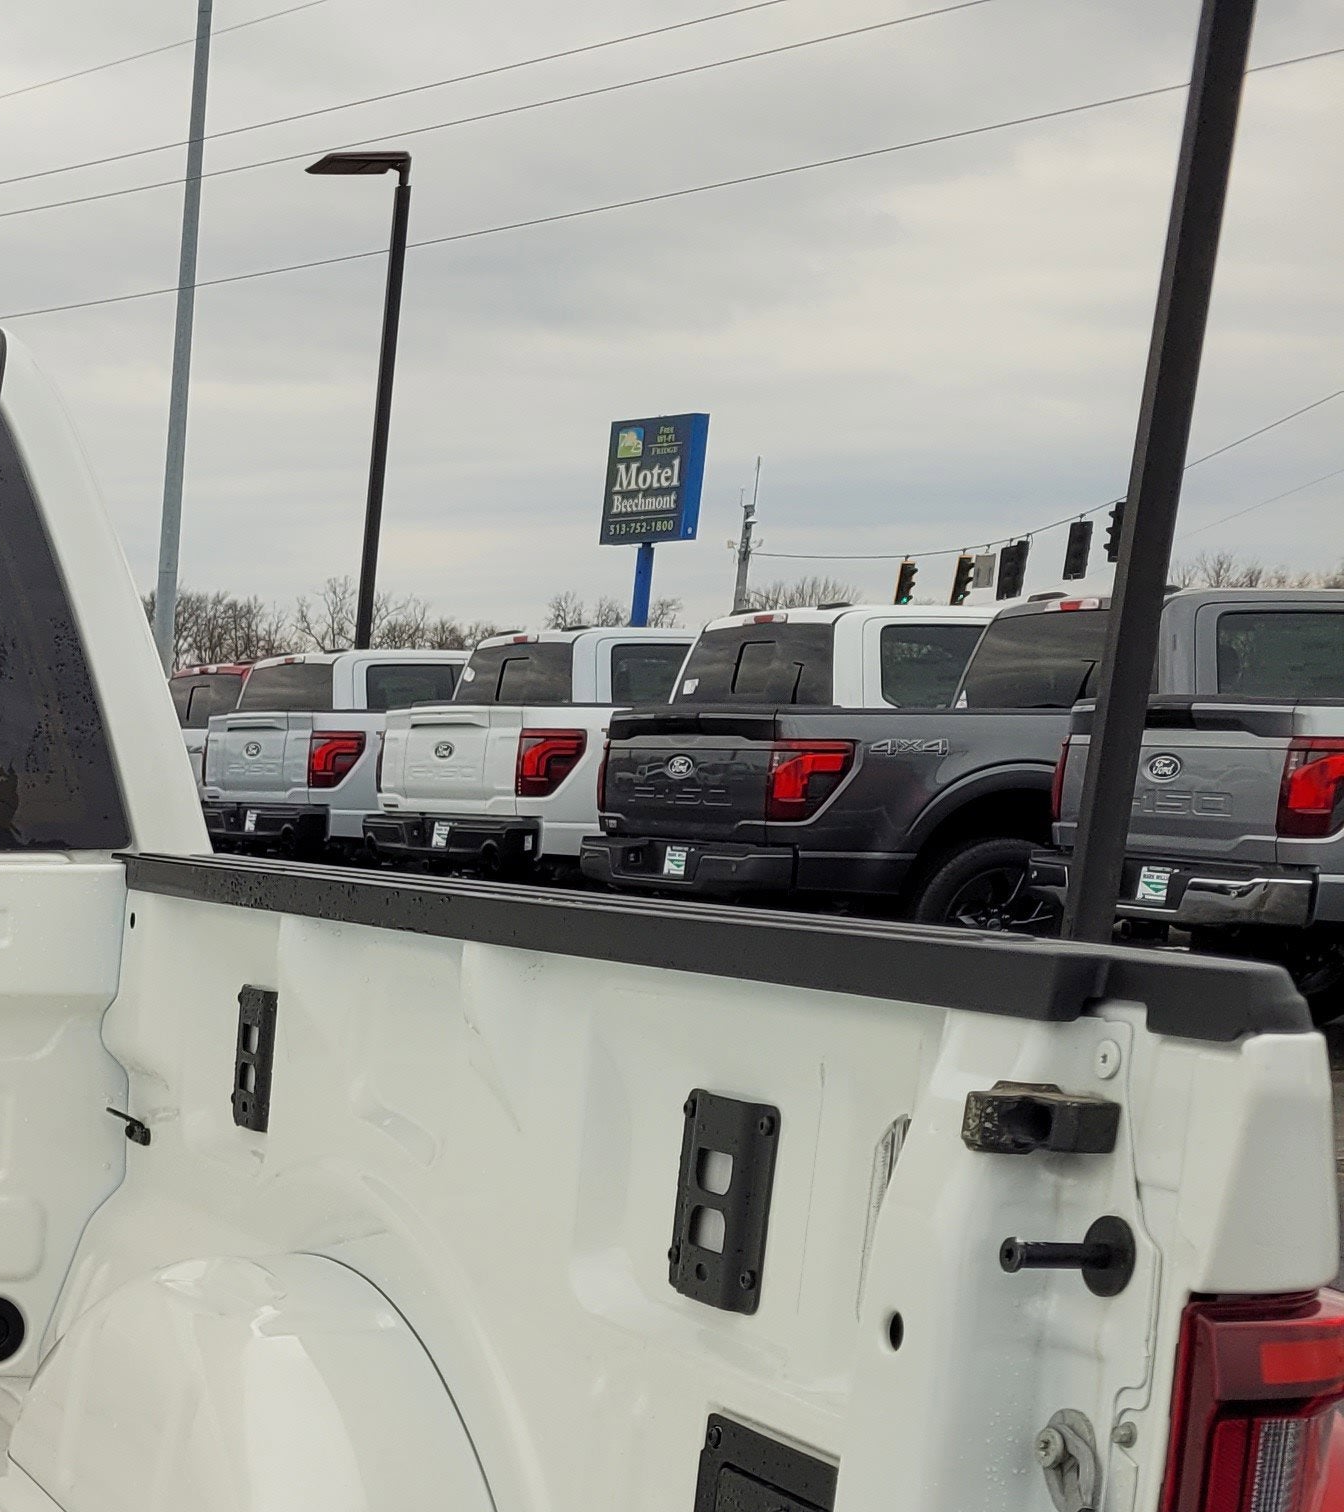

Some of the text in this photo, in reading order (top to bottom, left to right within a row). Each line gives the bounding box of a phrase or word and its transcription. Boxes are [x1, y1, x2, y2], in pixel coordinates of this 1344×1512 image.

[612, 456, 681, 492] Motel
[611, 492, 676, 515] Beechmont
[609, 520, 674, 536] 513-752-1800
[671, 759, 690, 773] Ford
[1152, 759, 1175, 775] Ford
